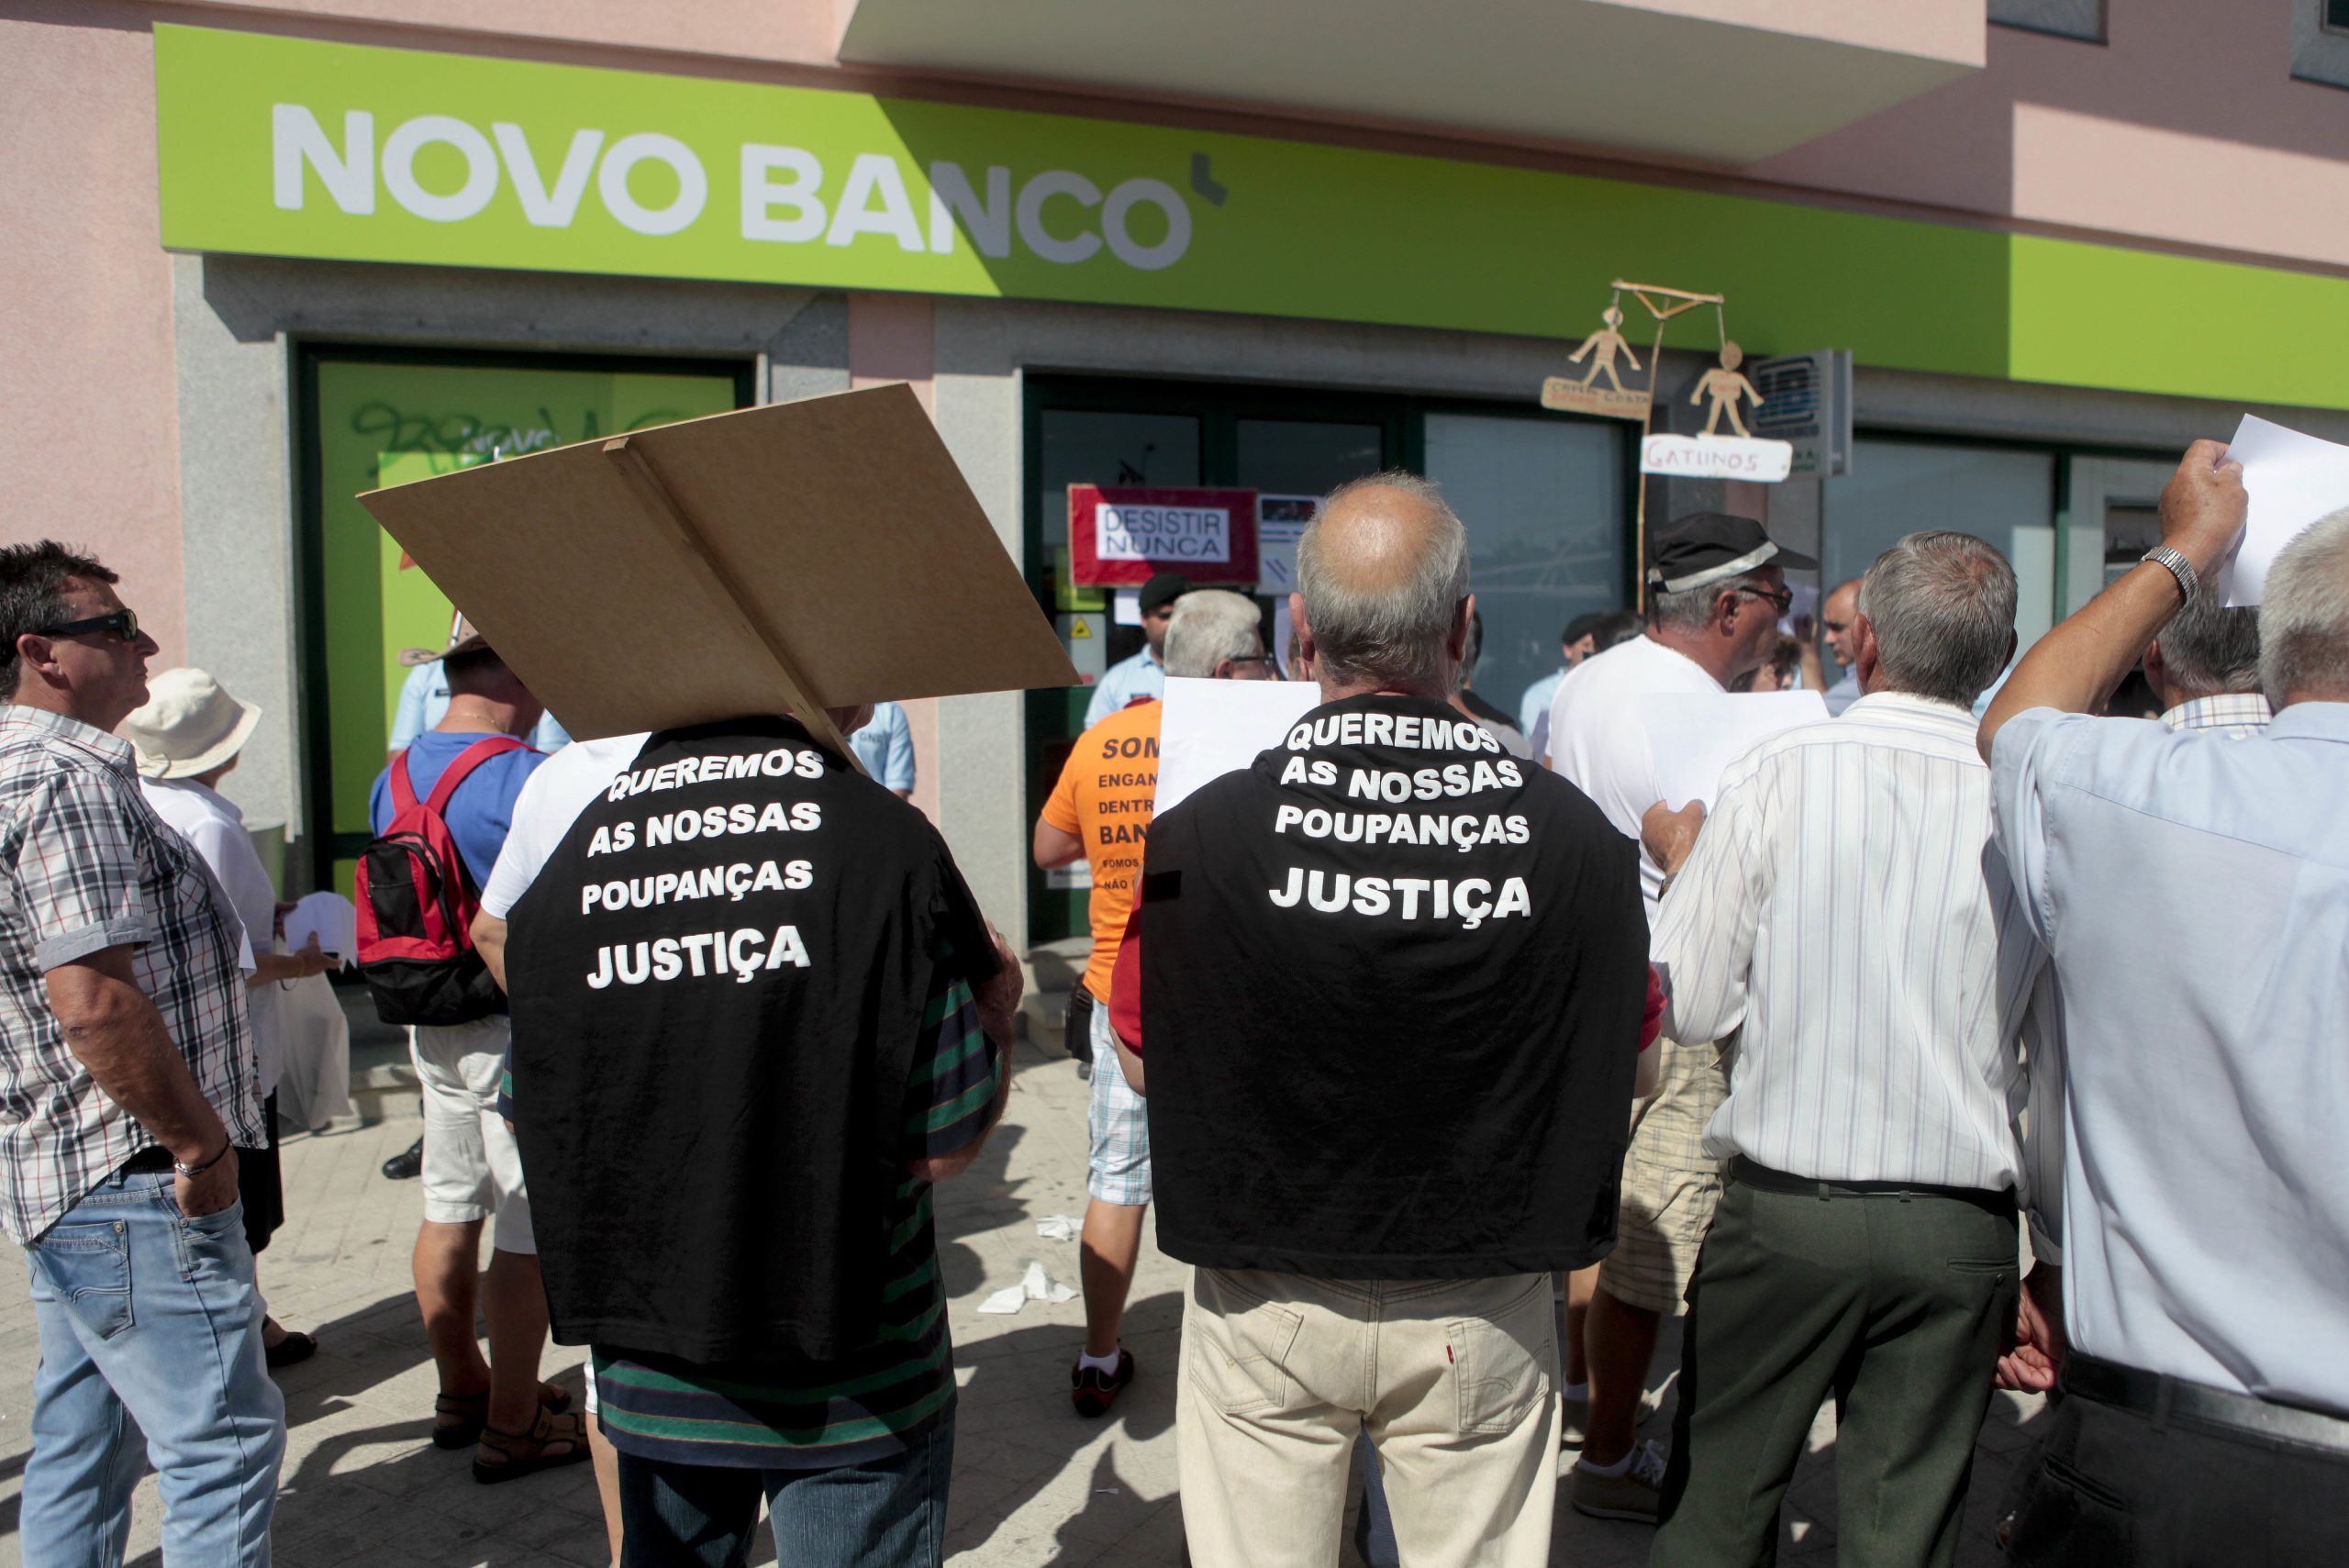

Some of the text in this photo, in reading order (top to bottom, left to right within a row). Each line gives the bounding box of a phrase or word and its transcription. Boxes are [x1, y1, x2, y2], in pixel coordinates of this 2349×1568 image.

[273, 103, 1192, 270] NOVO BANCO
[1105, 509, 1221, 536] DESISTIR
[1105, 536, 1221, 557] NUNCA
[1286, 713, 1500, 754] QUEREMOS
[607, 749, 825, 802] QUEREMOS
[1280, 756, 1523, 803] AS NOSSAS
[587, 802, 822, 858] AS NOSSAS
[1275, 805, 1531, 852] POUPANÇAS
[582, 860, 814, 916] POUPANÇAS
[1269, 867, 1531, 929] JUSTIÇA
[586, 925, 811, 989] JUSTIÇA
